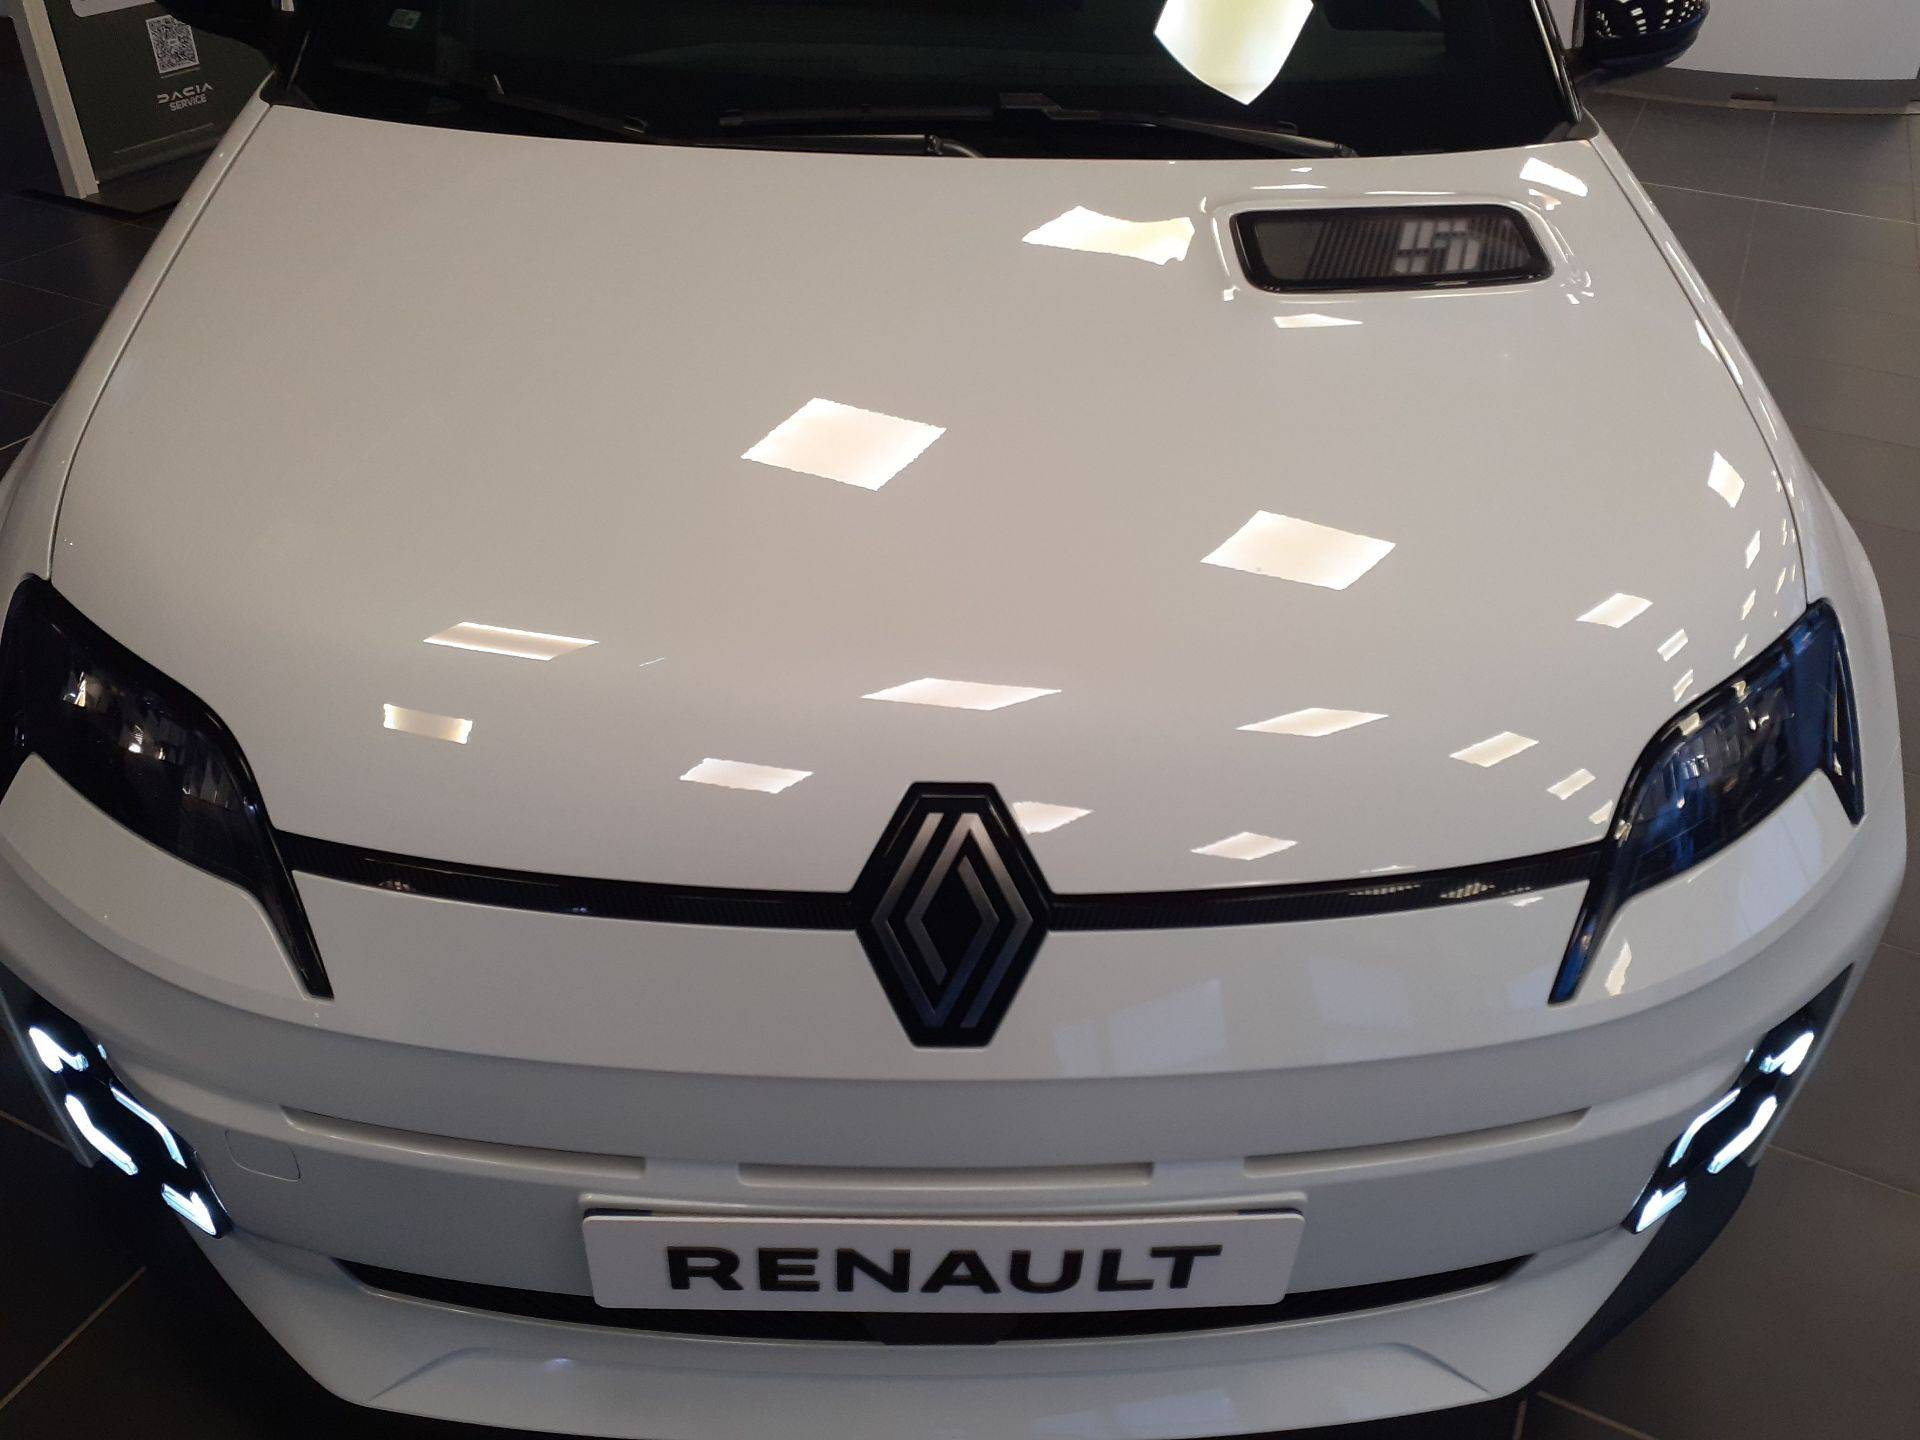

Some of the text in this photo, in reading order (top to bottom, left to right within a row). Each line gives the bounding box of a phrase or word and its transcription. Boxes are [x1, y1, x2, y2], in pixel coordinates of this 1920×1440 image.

[157, 82, 213, 104] DACIA
[169, 93, 207, 112] SERVICE
[666, 1244, 1223, 1294] RENAULT
